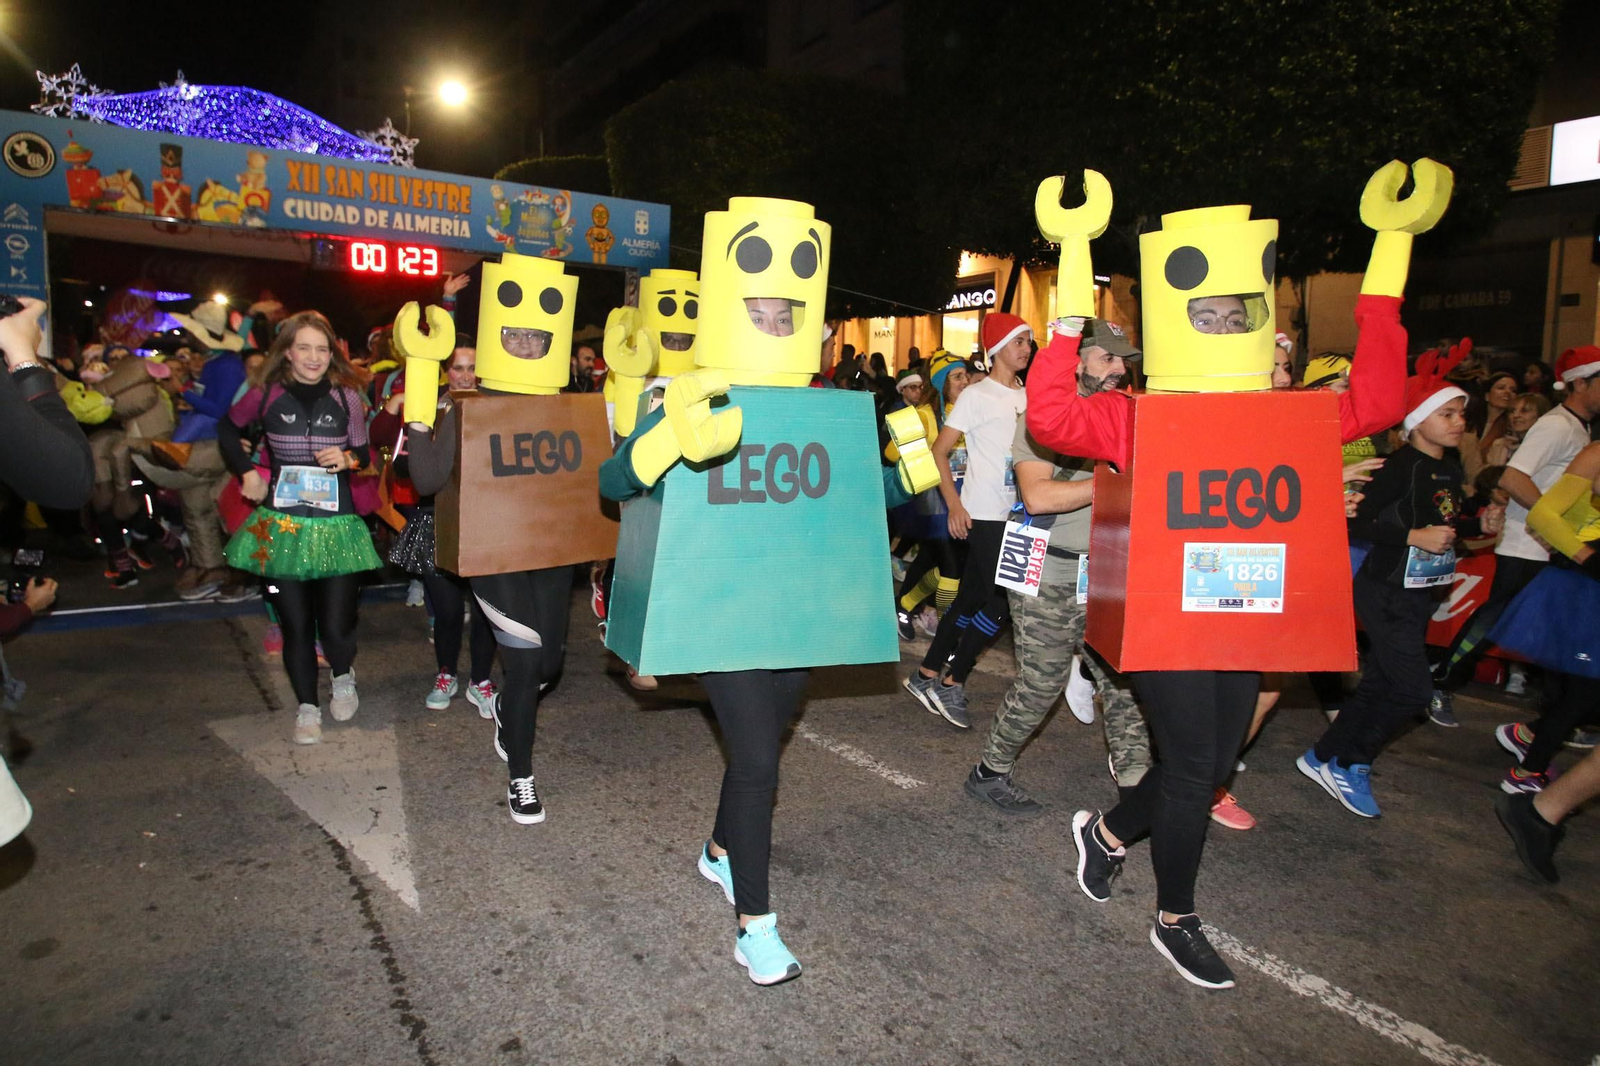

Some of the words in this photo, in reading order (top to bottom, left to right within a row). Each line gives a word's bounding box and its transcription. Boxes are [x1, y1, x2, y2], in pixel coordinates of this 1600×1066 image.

[286, 160, 320, 194] XII
[324, 165, 364, 199] SAN
[368, 171, 472, 214] SILVESTRE
[283, 198, 360, 226] CIUDAD
[364, 207, 389, 229] DE
[392, 211, 471, 239] ALMERÍA
[621, 237, 661, 250] ALMERÍA
[628, 248, 655, 258] CIUDAD
[946, 288, 997, 310] ANGO
[489, 430, 582, 477] LEGO
[707, 441, 831, 504] LEGO
[1166, 464, 1302, 530] LEGO
[998, 531, 1035, 584] man
[1024, 537, 1047, 588] GEYPER
[1224, 563, 1278, 581] 1826
[1233, 582, 1257, 592] PAULA
